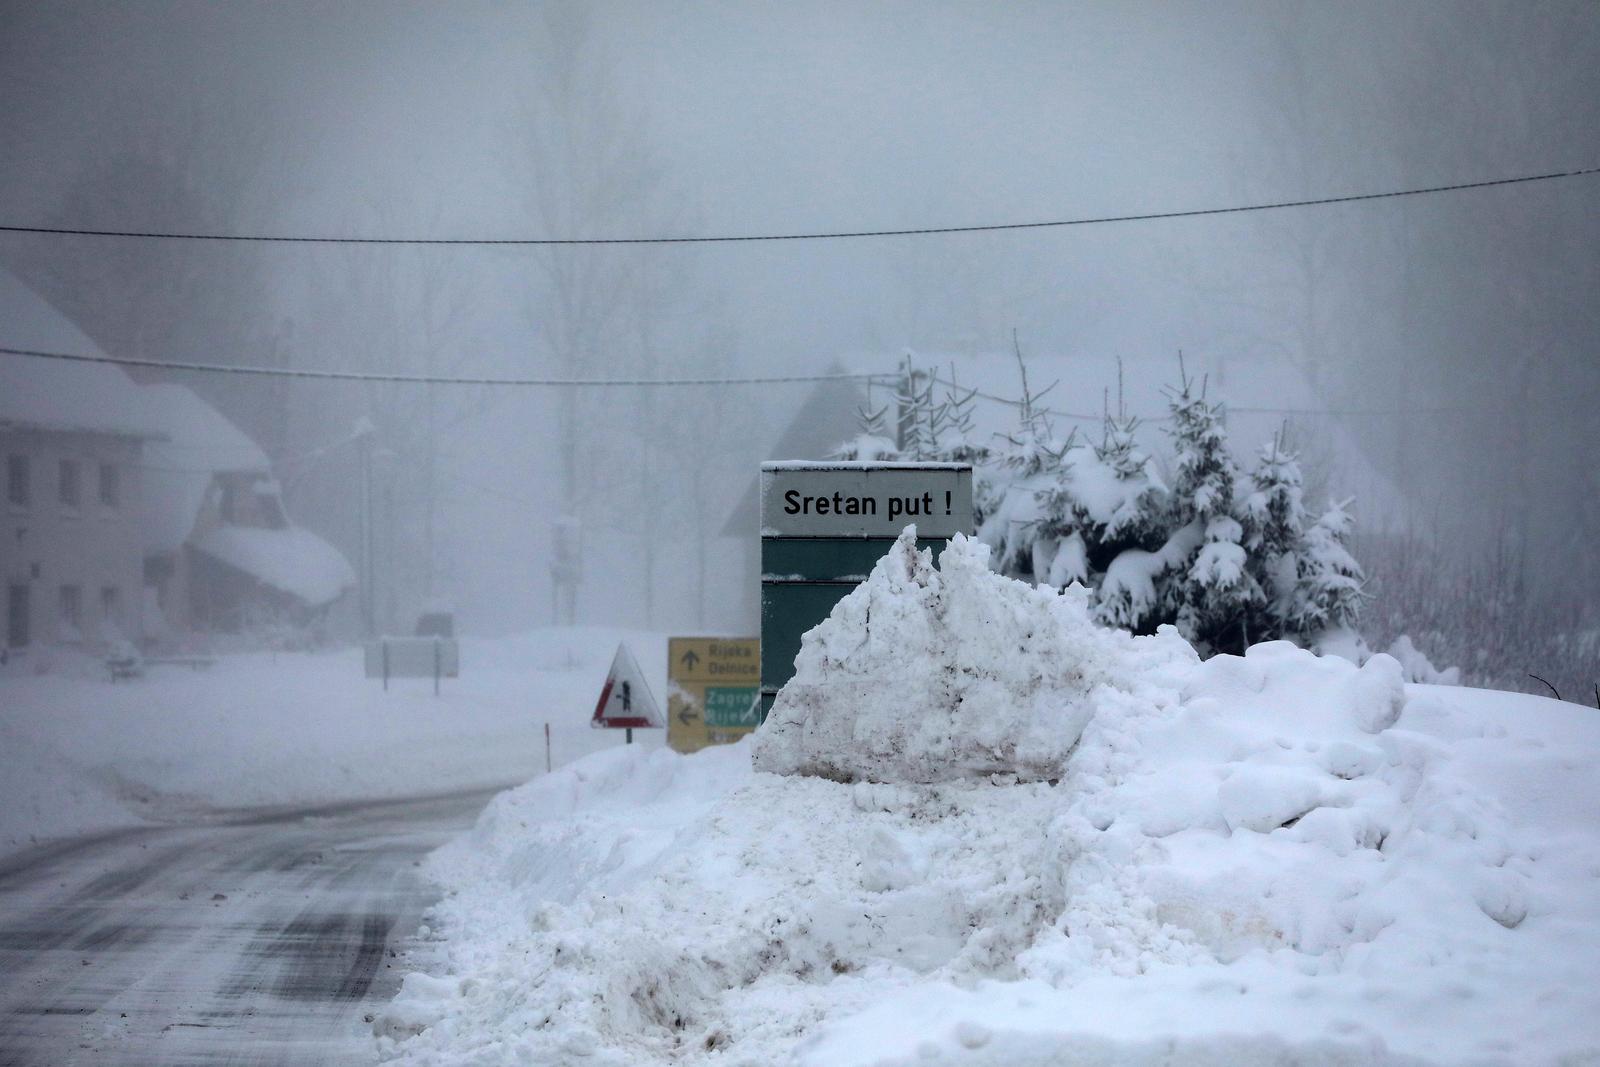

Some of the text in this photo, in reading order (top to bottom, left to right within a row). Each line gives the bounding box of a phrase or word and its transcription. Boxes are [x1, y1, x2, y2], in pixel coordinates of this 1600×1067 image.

[784, 489, 876, 516] Sretan
[888, 491, 933, 522] put
[709, 644, 752, 659] Rijeka
[709, 662, 758, 674] Delnice
